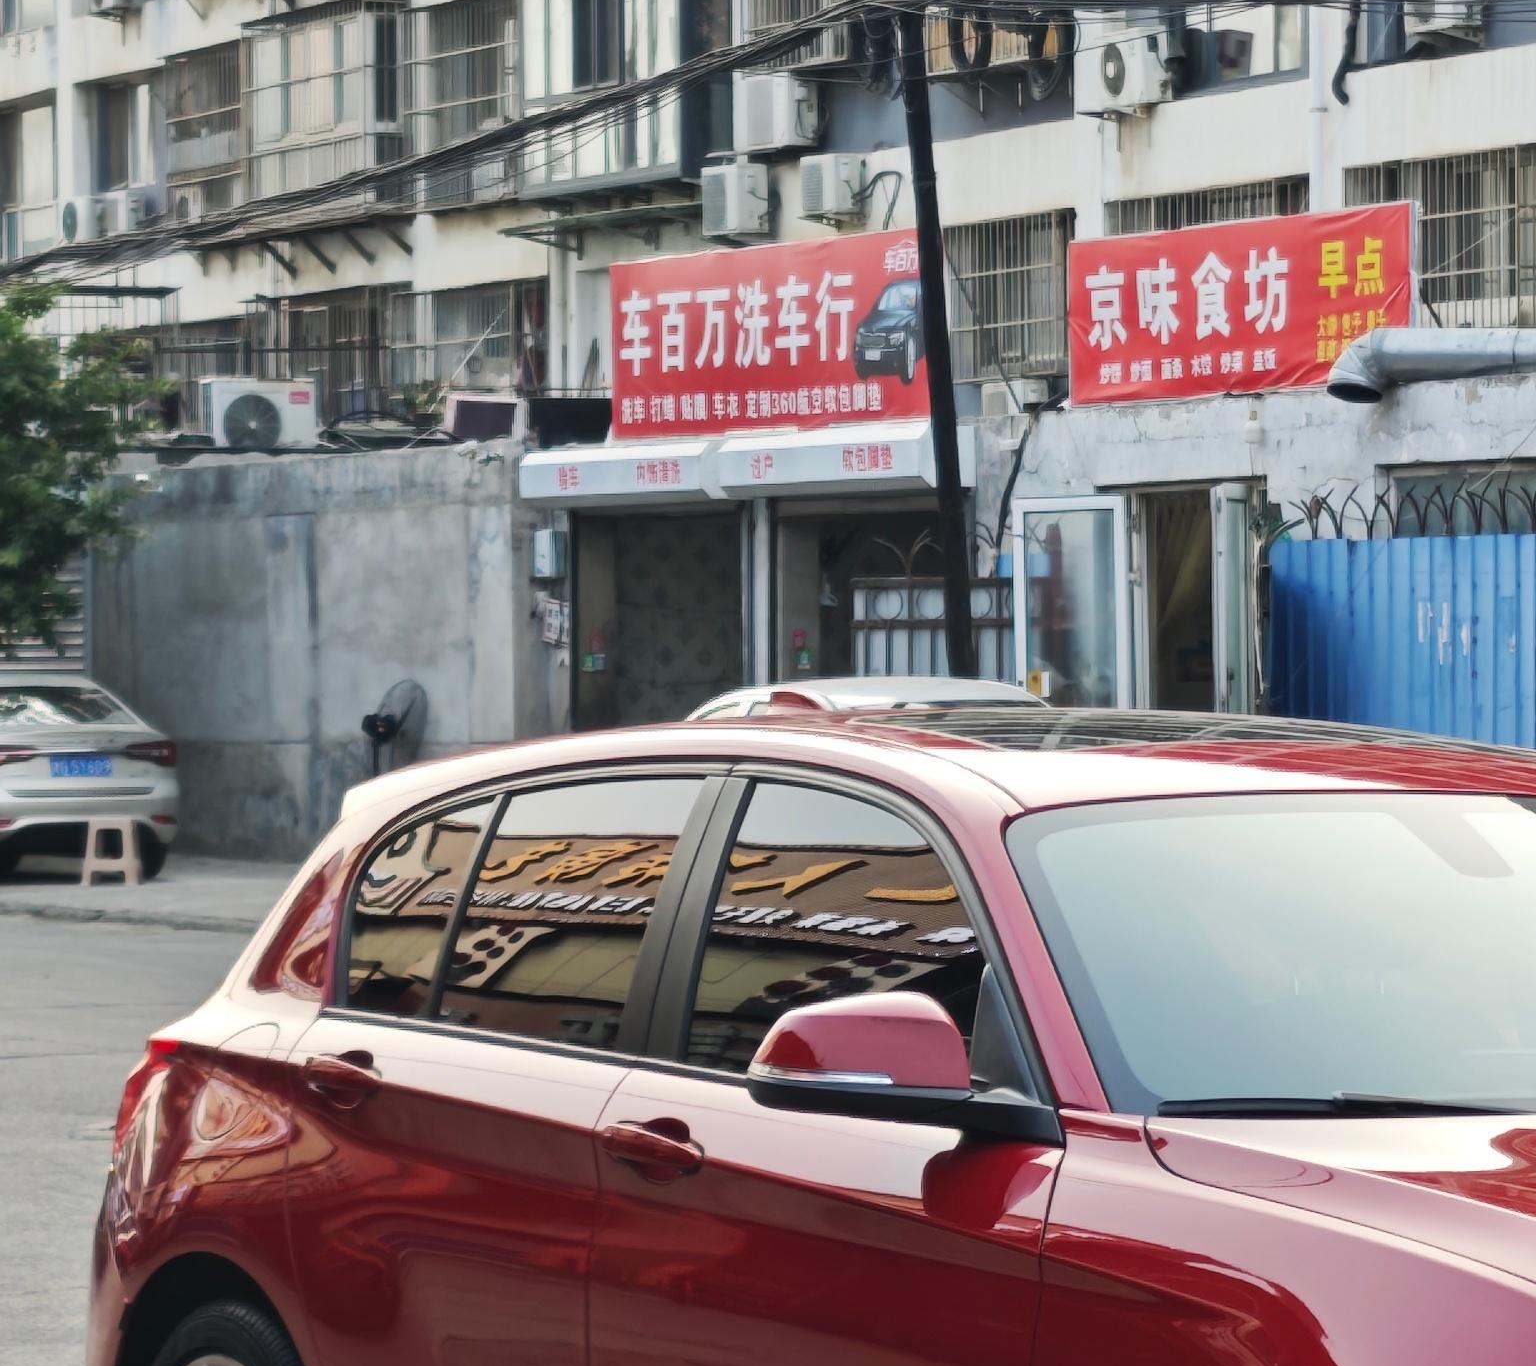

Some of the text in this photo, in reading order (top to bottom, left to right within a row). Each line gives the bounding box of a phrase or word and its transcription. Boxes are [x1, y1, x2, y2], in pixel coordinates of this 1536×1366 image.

[1085, 246, 1289, 351] 京味食坊
[1318, 236, 1386, 299] 早点
[619, 270, 855, 377] 车百万洗车行
